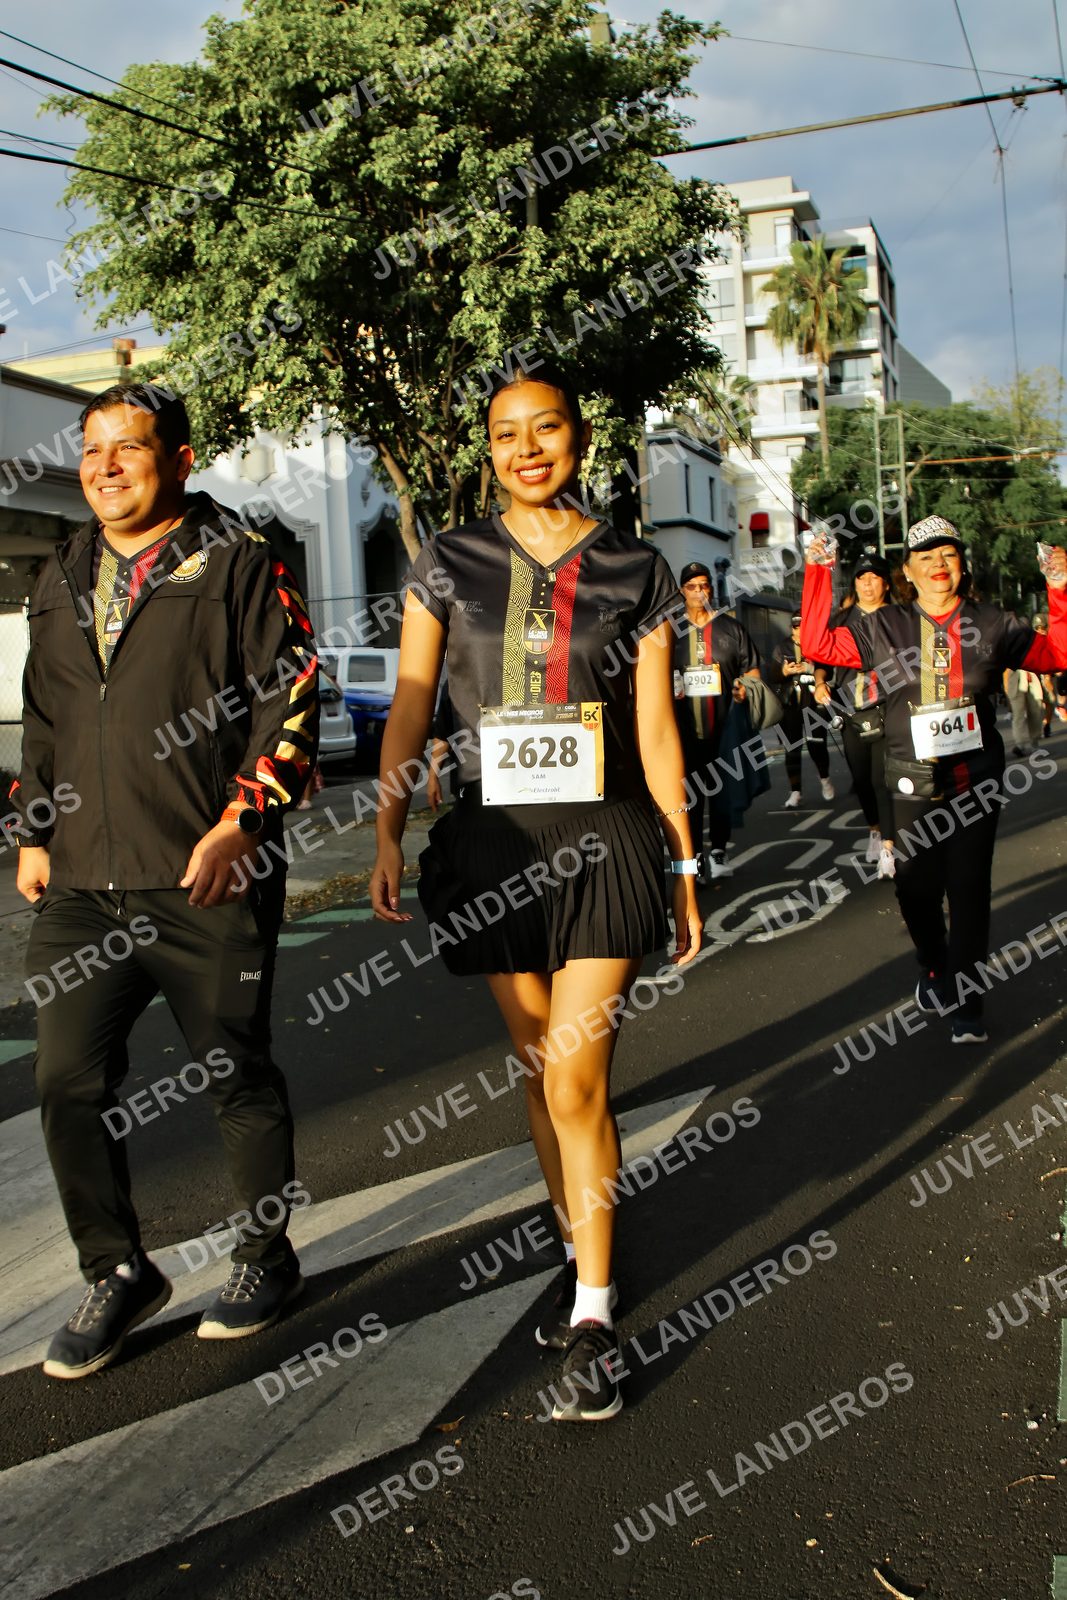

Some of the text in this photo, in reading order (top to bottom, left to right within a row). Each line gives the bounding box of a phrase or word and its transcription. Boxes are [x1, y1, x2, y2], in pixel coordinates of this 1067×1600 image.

[688, 674, 713, 686] 2902
[583, 710, 598, 721] 5K
[929, 716, 964, 737] 964
[497, 735, 579, 769] 2628
